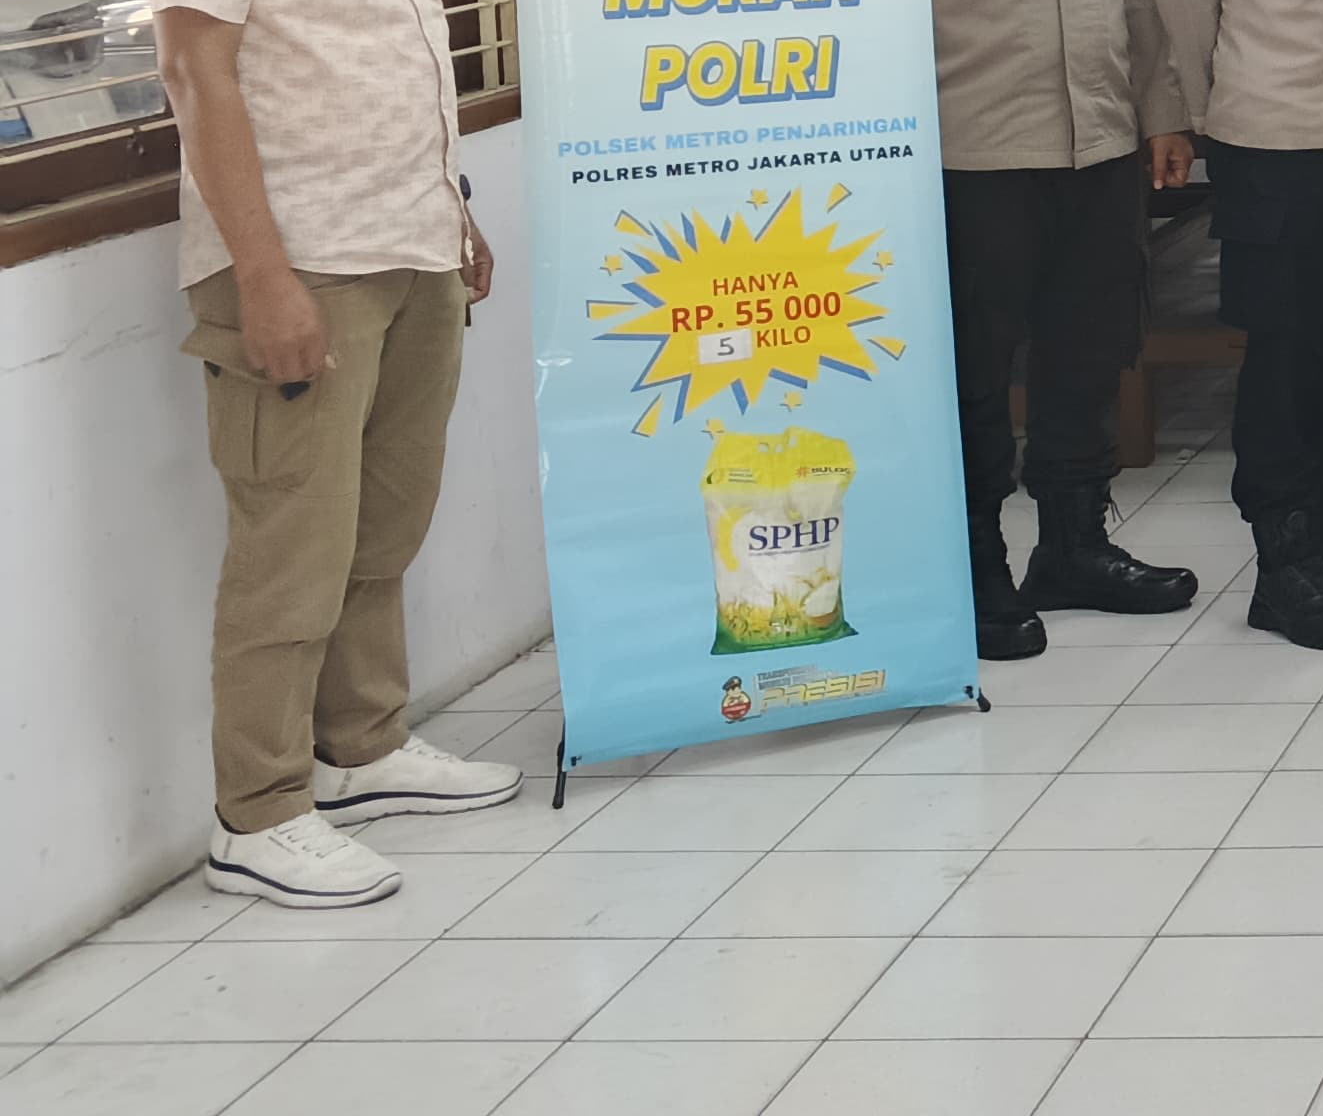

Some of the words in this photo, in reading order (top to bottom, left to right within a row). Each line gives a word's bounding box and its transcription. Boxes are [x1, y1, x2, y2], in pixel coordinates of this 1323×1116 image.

[640, 35, 840, 111] POLRI
[557, 134, 657, 158] POLSEK
[664, 128, 750, 152] METRO
[756, 116, 918, 146] PENJARINGAN
[571, 163, 658, 184] POLRES
[665, 157, 741, 178] METRO
[747, 150, 843, 171] JAKARTA
[849, 145, 915, 163] UTARA
[712, 271, 799, 298] HANYA
[671, 304, 727, 334] RP.
[735, 296, 778, 327] 55
[783, 290, 842, 321] 000
[716, 336, 736, 357] 5
[756, 325, 812, 350] KILO
[748, 516, 840, 551] SPHP
[760, 668, 887, 713] PRESISI
